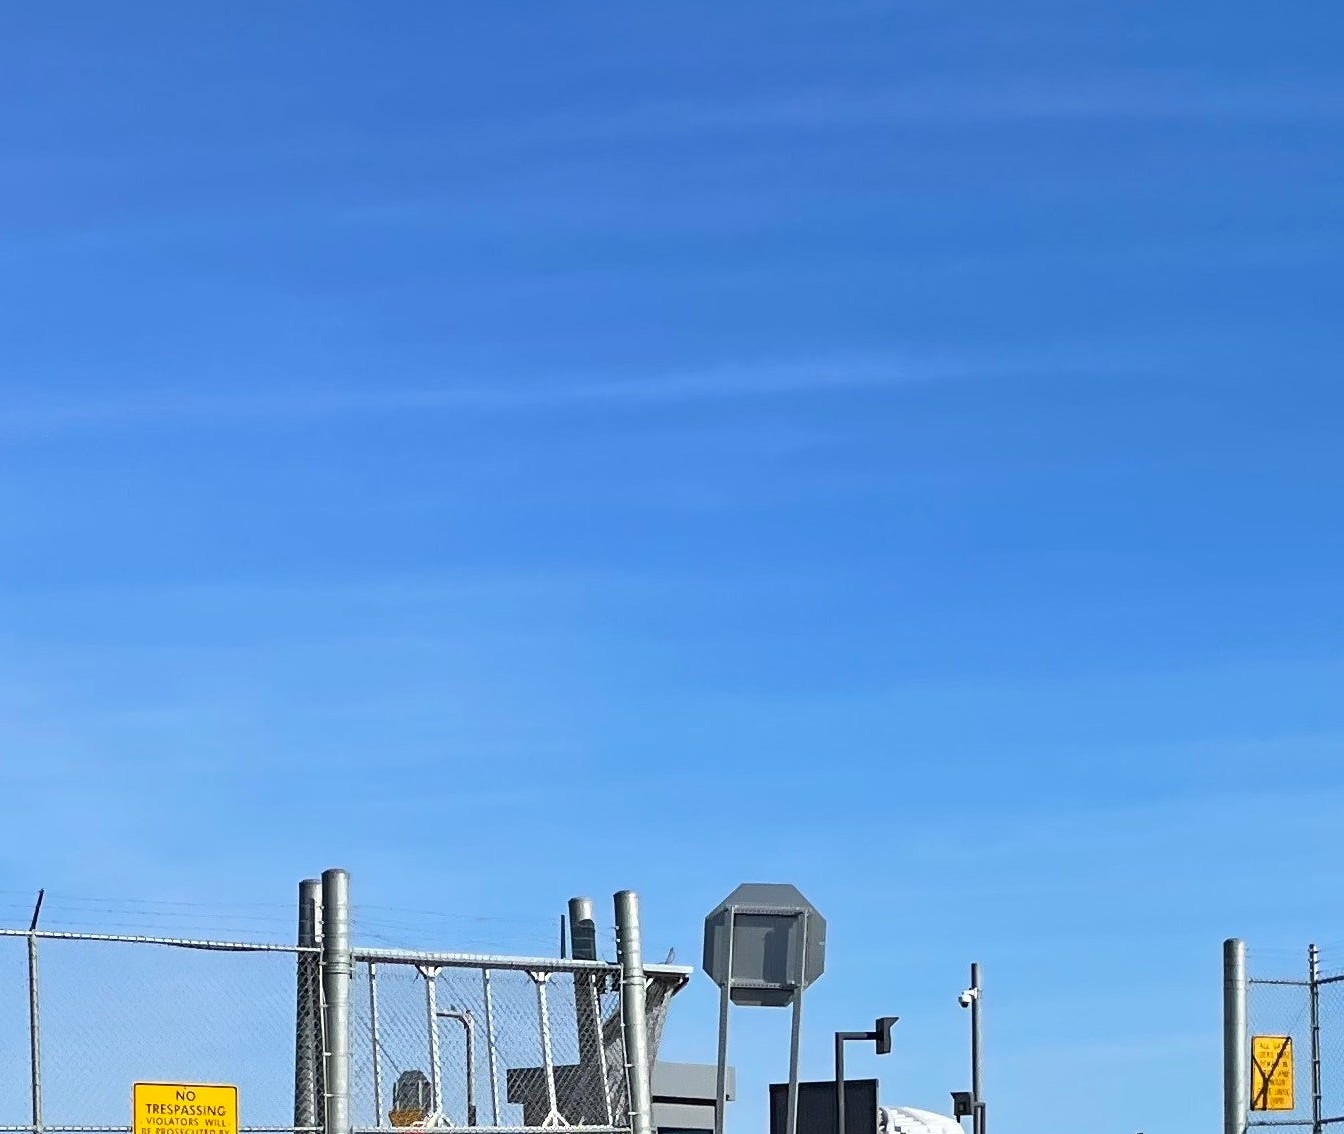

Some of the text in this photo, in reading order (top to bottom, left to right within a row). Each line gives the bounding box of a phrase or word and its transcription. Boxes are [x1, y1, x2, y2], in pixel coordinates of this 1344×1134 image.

[176, 1090, 196, 1101] NO
[145, 1103, 226, 1116] TRESPASSING
[146, 1117, 226, 1127] VIOLATORS WILL
